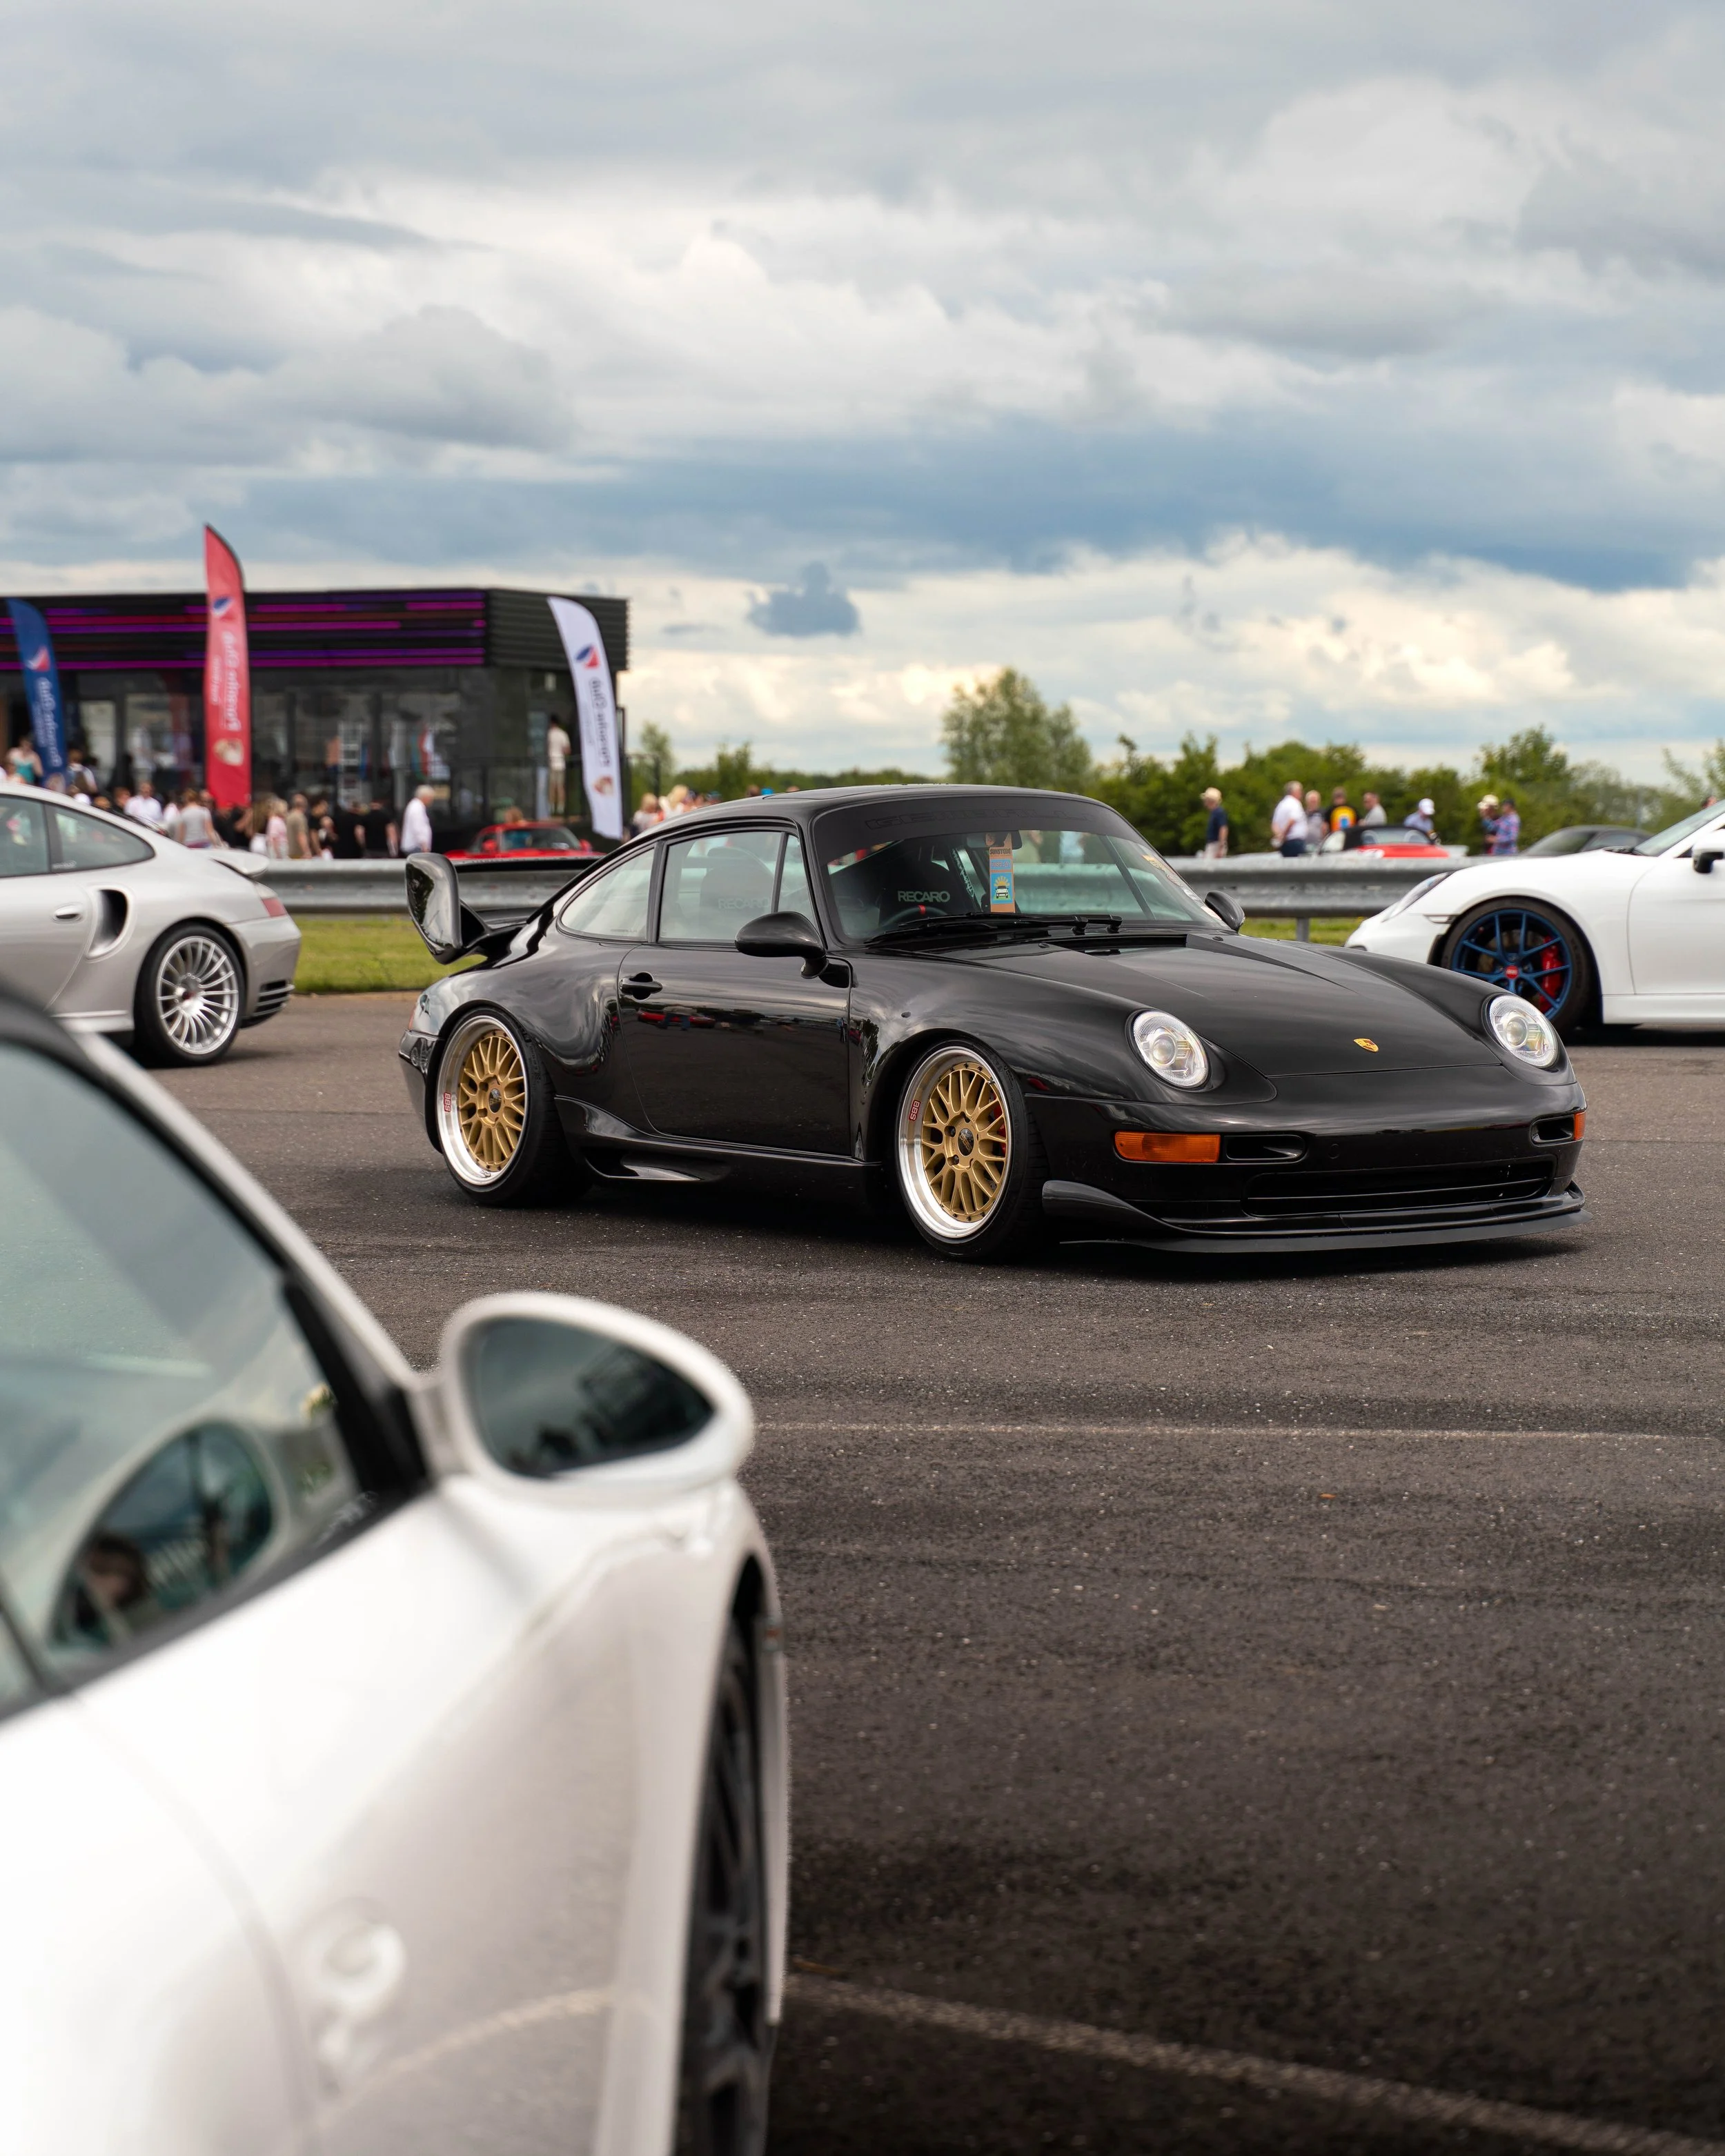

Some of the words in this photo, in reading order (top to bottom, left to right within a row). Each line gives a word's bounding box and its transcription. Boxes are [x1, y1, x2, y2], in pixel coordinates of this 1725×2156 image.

[898, 891, 950, 902] RECARO
[718, 898, 770, 909] RECARO
[910, 1100, 920, 1120] BBS
